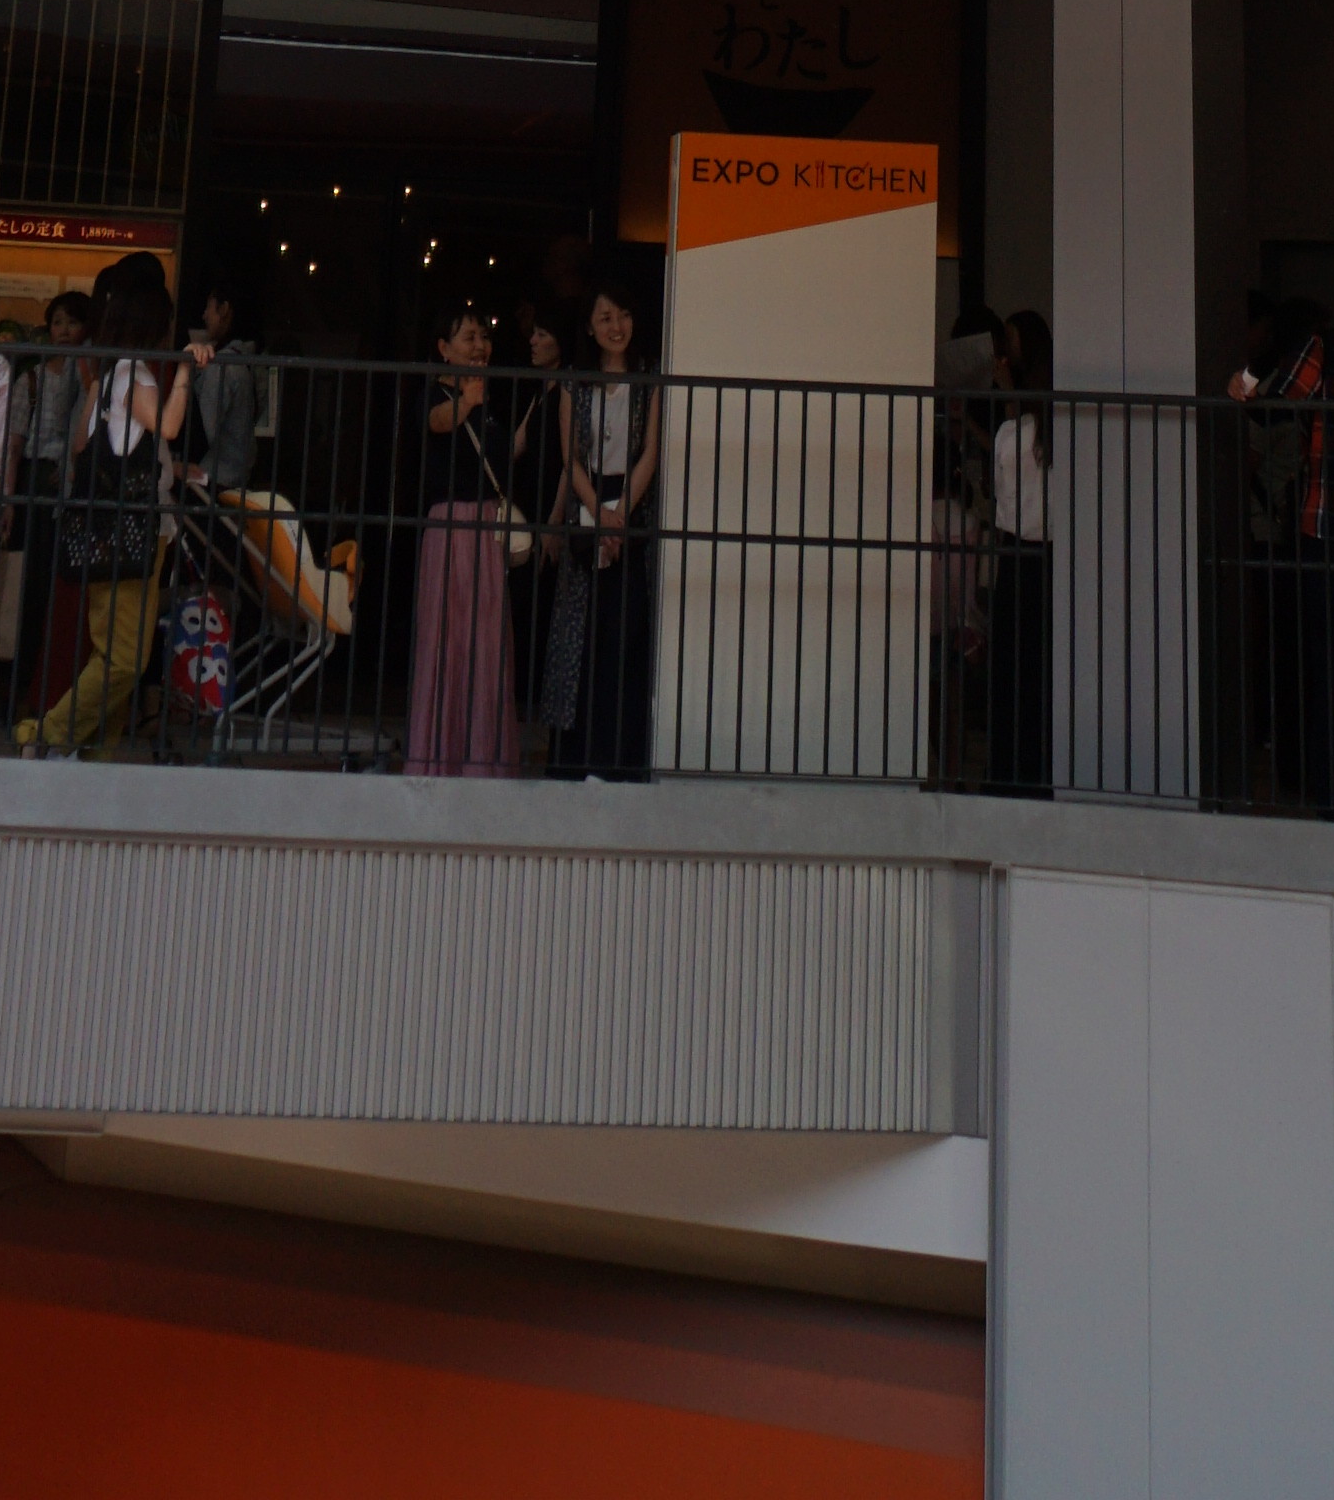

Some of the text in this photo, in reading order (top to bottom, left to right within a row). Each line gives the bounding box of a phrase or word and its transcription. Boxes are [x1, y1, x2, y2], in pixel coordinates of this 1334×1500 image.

[712, 2, 882, 81] わたし
[691, 157, 926, 194] EXPO KITCHEN
